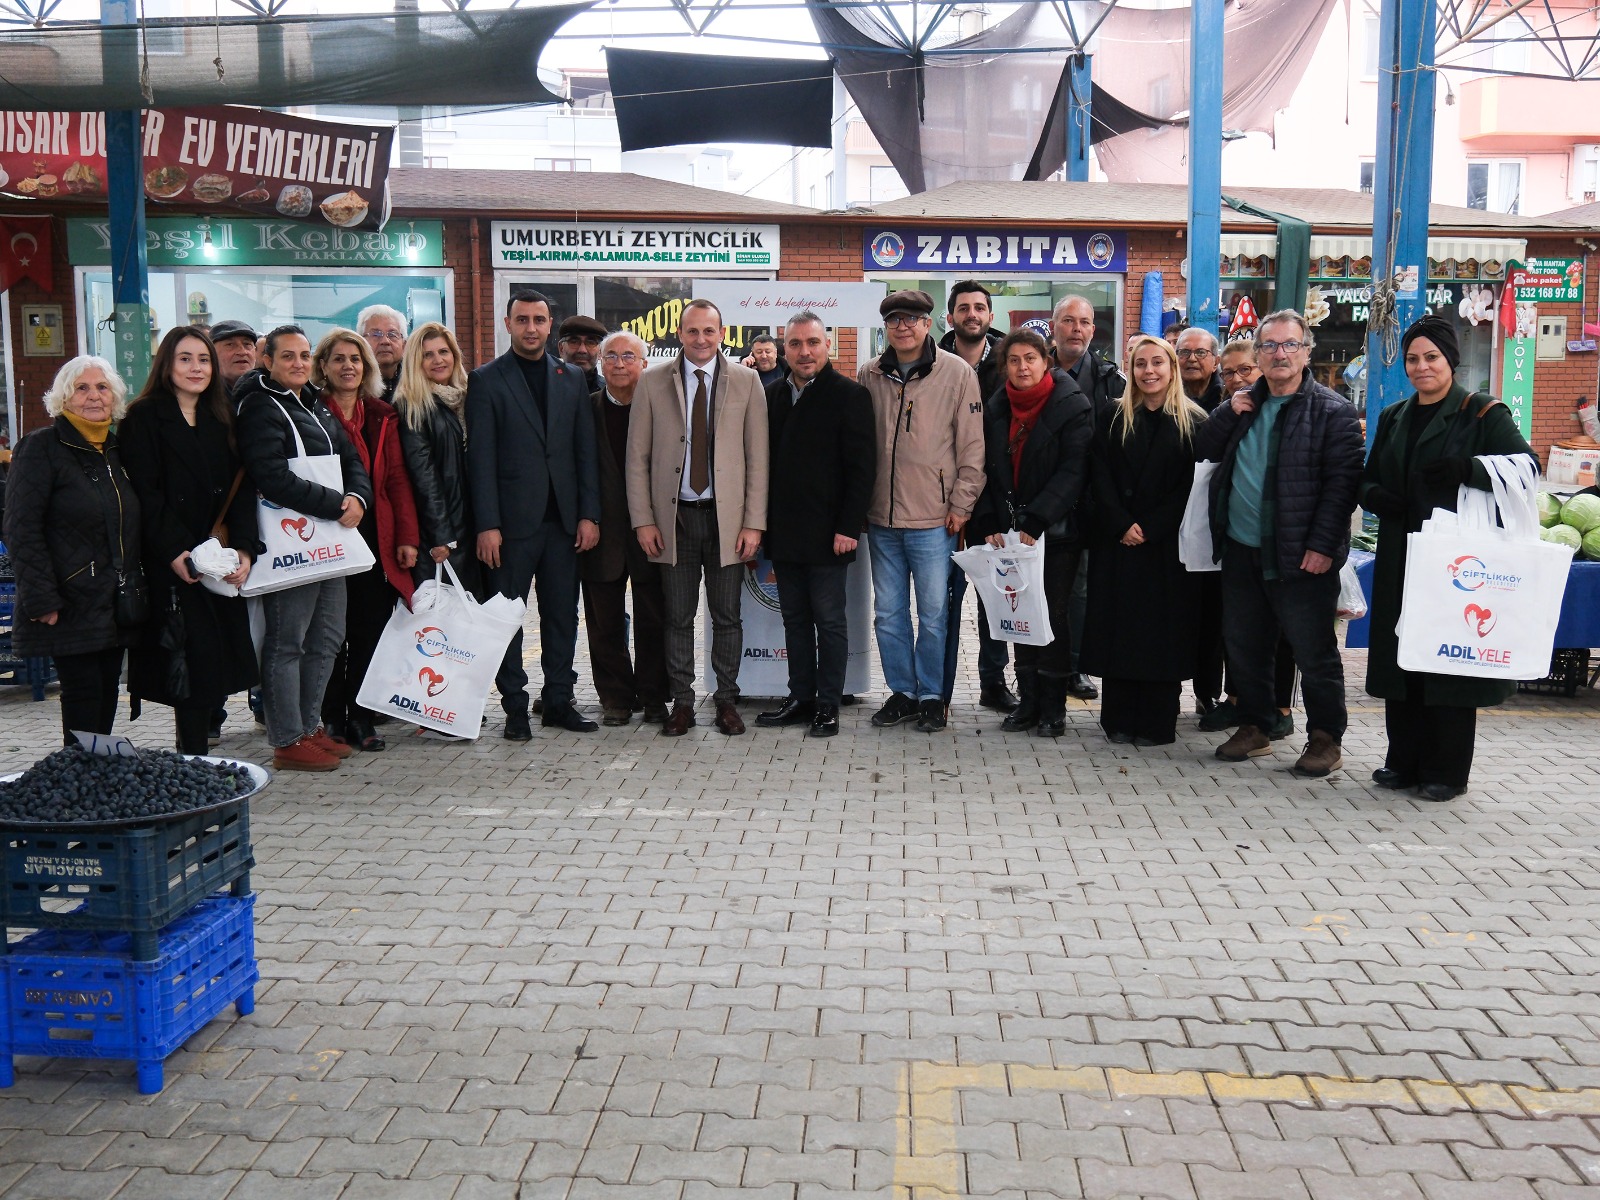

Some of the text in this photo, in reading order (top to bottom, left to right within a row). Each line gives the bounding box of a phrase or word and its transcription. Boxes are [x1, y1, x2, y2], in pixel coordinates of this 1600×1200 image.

[179, 116, 217, 167] EV
[226, 122, 378, 189] YEMEKLERİ
[252, 223, 427, 258] Kebap
[294, 251, 394, 261] BAKLAVA
[685, 249, 730, 262] ZEYTİNİ
[917, 235, 1079, 264] ZABITA
[1540, 276, 1562, 284] paket
[1520, 287, 1536, 298] 532
[1538, 287, 1553, 298] 168
[1555, 288, 1566, 298] 97
[1567, 288, 1578, 299] 88
[740, 296, 752, 308] el
[755, 296, 770, 308] ele
[1513, 308, 1526, 381] YALOVA
[307, 544, 345, 562] YELE
[1462, 570, 1522, 583] ÇİFTLİKKÖY
[1014, 621, 1030, 632] YELE
[426, 638, 476, 660] ÇİFTLİKKÖY
[1476, 647, 1511, 663] YELE
[423, 704, 456, 723] YELE
[85, 858, 100, 866] HAL
[24, 863, 103, 877] SOBACILAR
